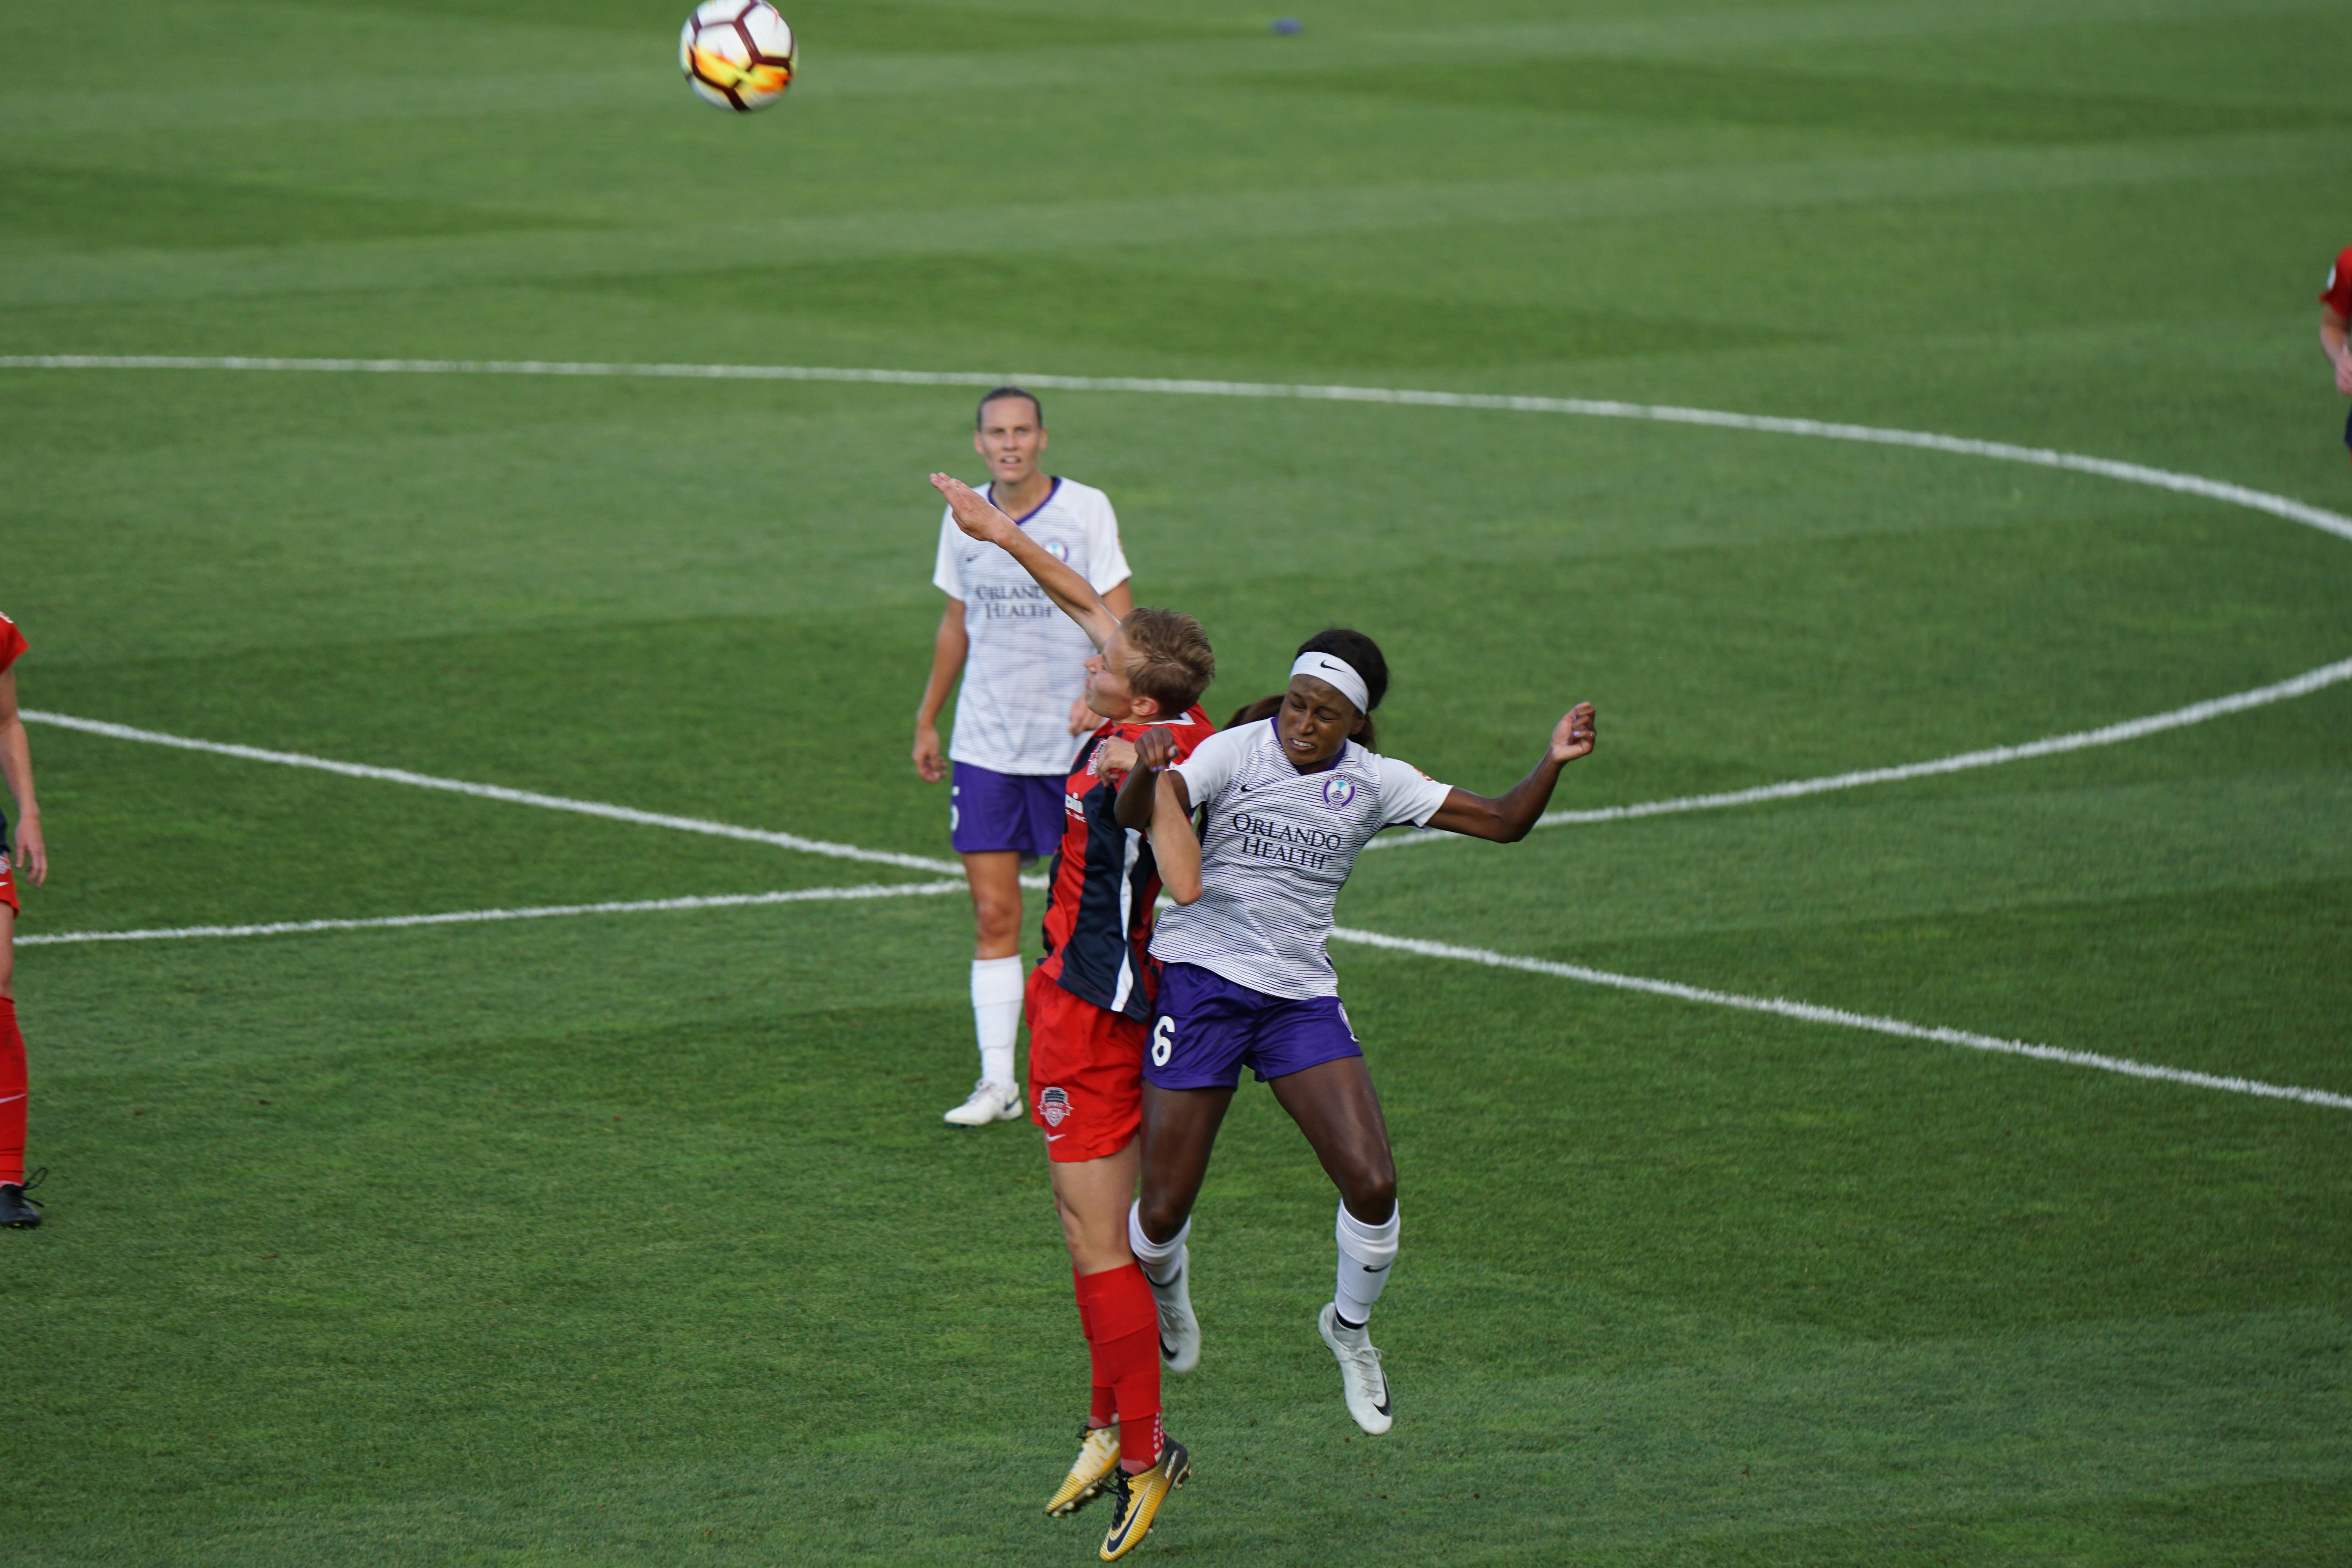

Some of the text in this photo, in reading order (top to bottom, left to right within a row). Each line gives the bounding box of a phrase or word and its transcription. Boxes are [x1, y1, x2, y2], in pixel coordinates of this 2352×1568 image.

[975, 584, 1048, 599] ORLAND
[985, 603, 1052, 619] HEALTH
[1329, 775, 1354, 787] ORLANDO
[1234, 813, 1341, 851] ORLANDO
[1241, 836, 1327, 869] HEALTH
[1151, 1015, 1176, 1067] 6
